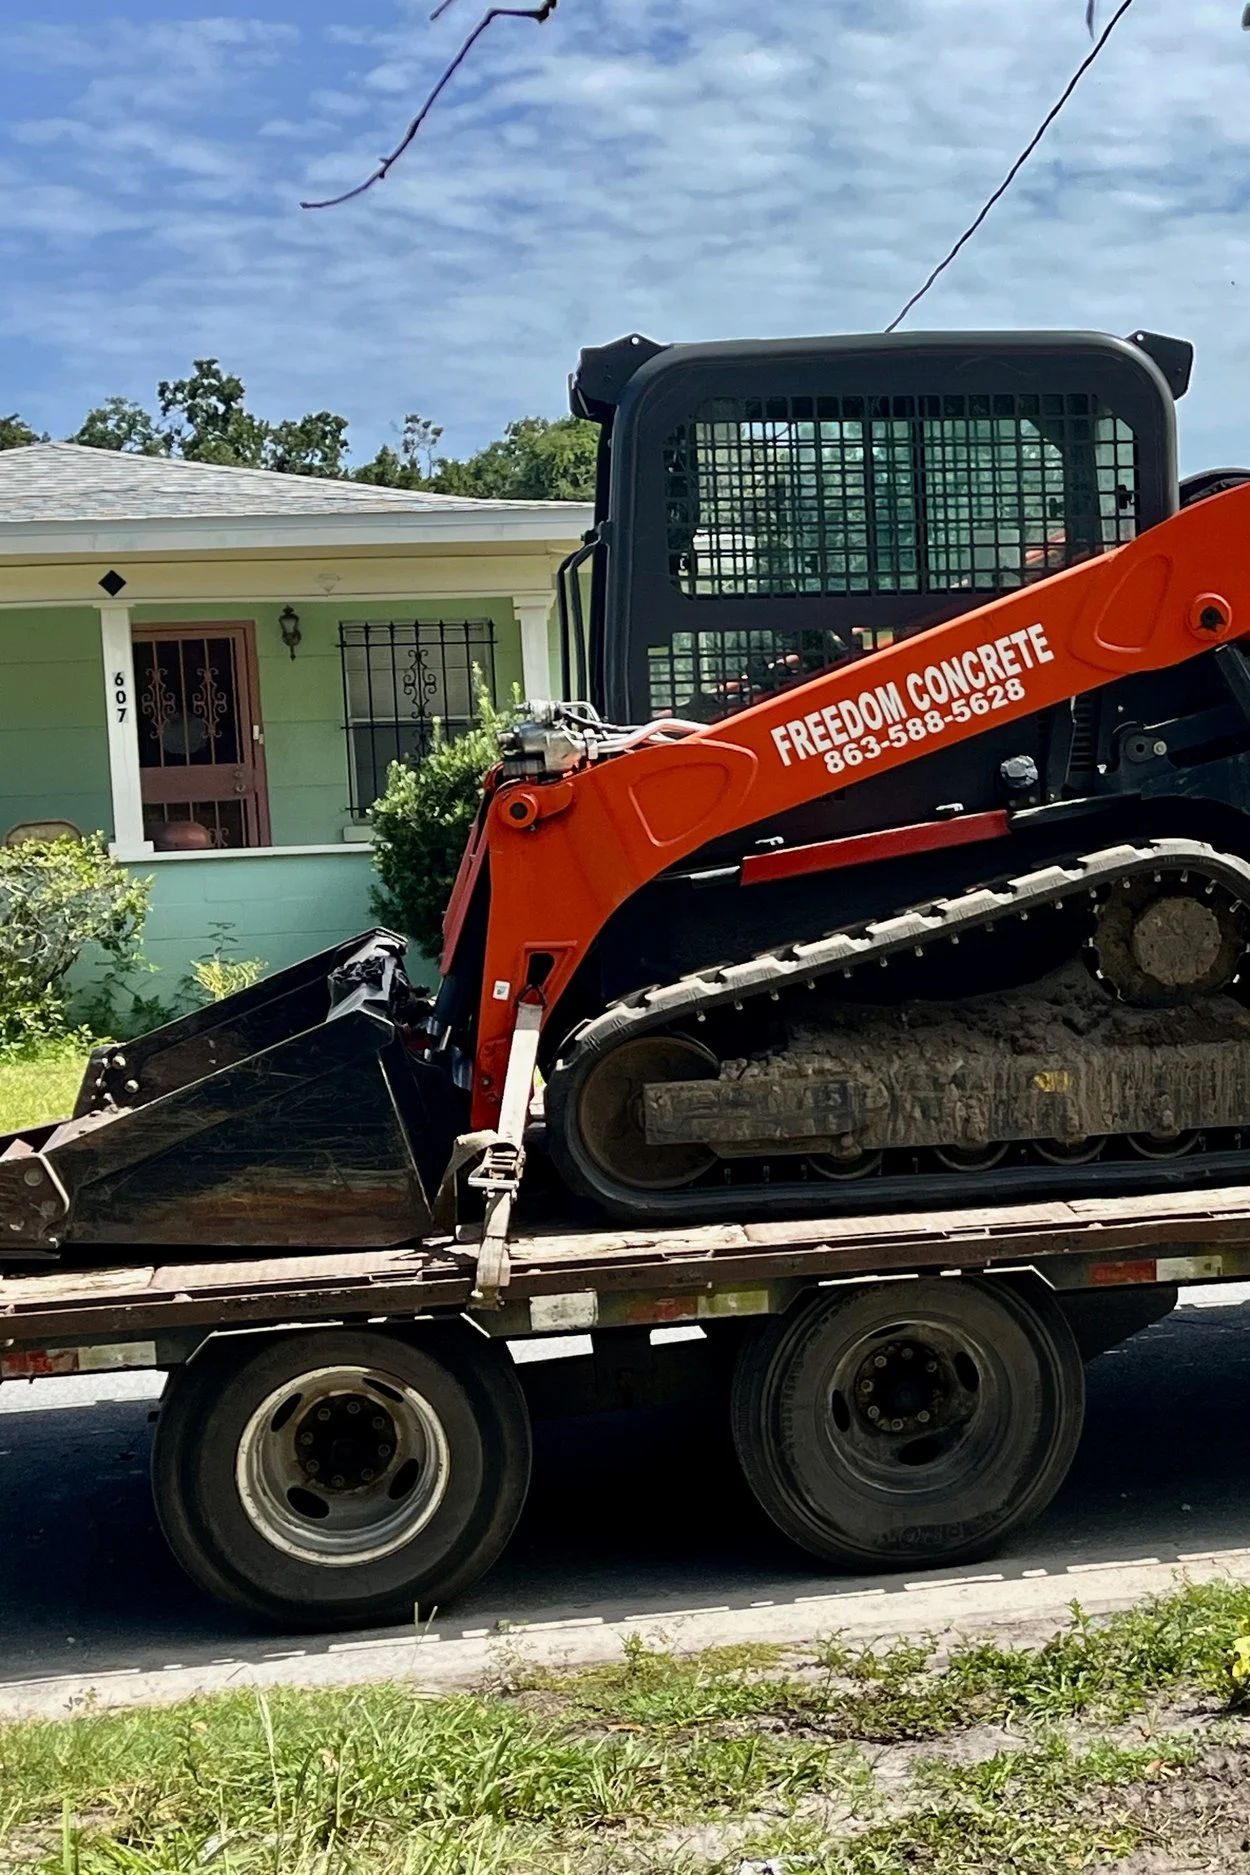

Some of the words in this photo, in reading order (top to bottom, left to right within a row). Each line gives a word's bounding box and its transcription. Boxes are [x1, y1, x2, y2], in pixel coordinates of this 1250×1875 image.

[114, 672, 127, 723] 607
[771, 682, 908, 767] FREEDOM
[906, 623, 1055, 712] CONCRETE
[823, 678, 1026, 774] 863-588-5628
